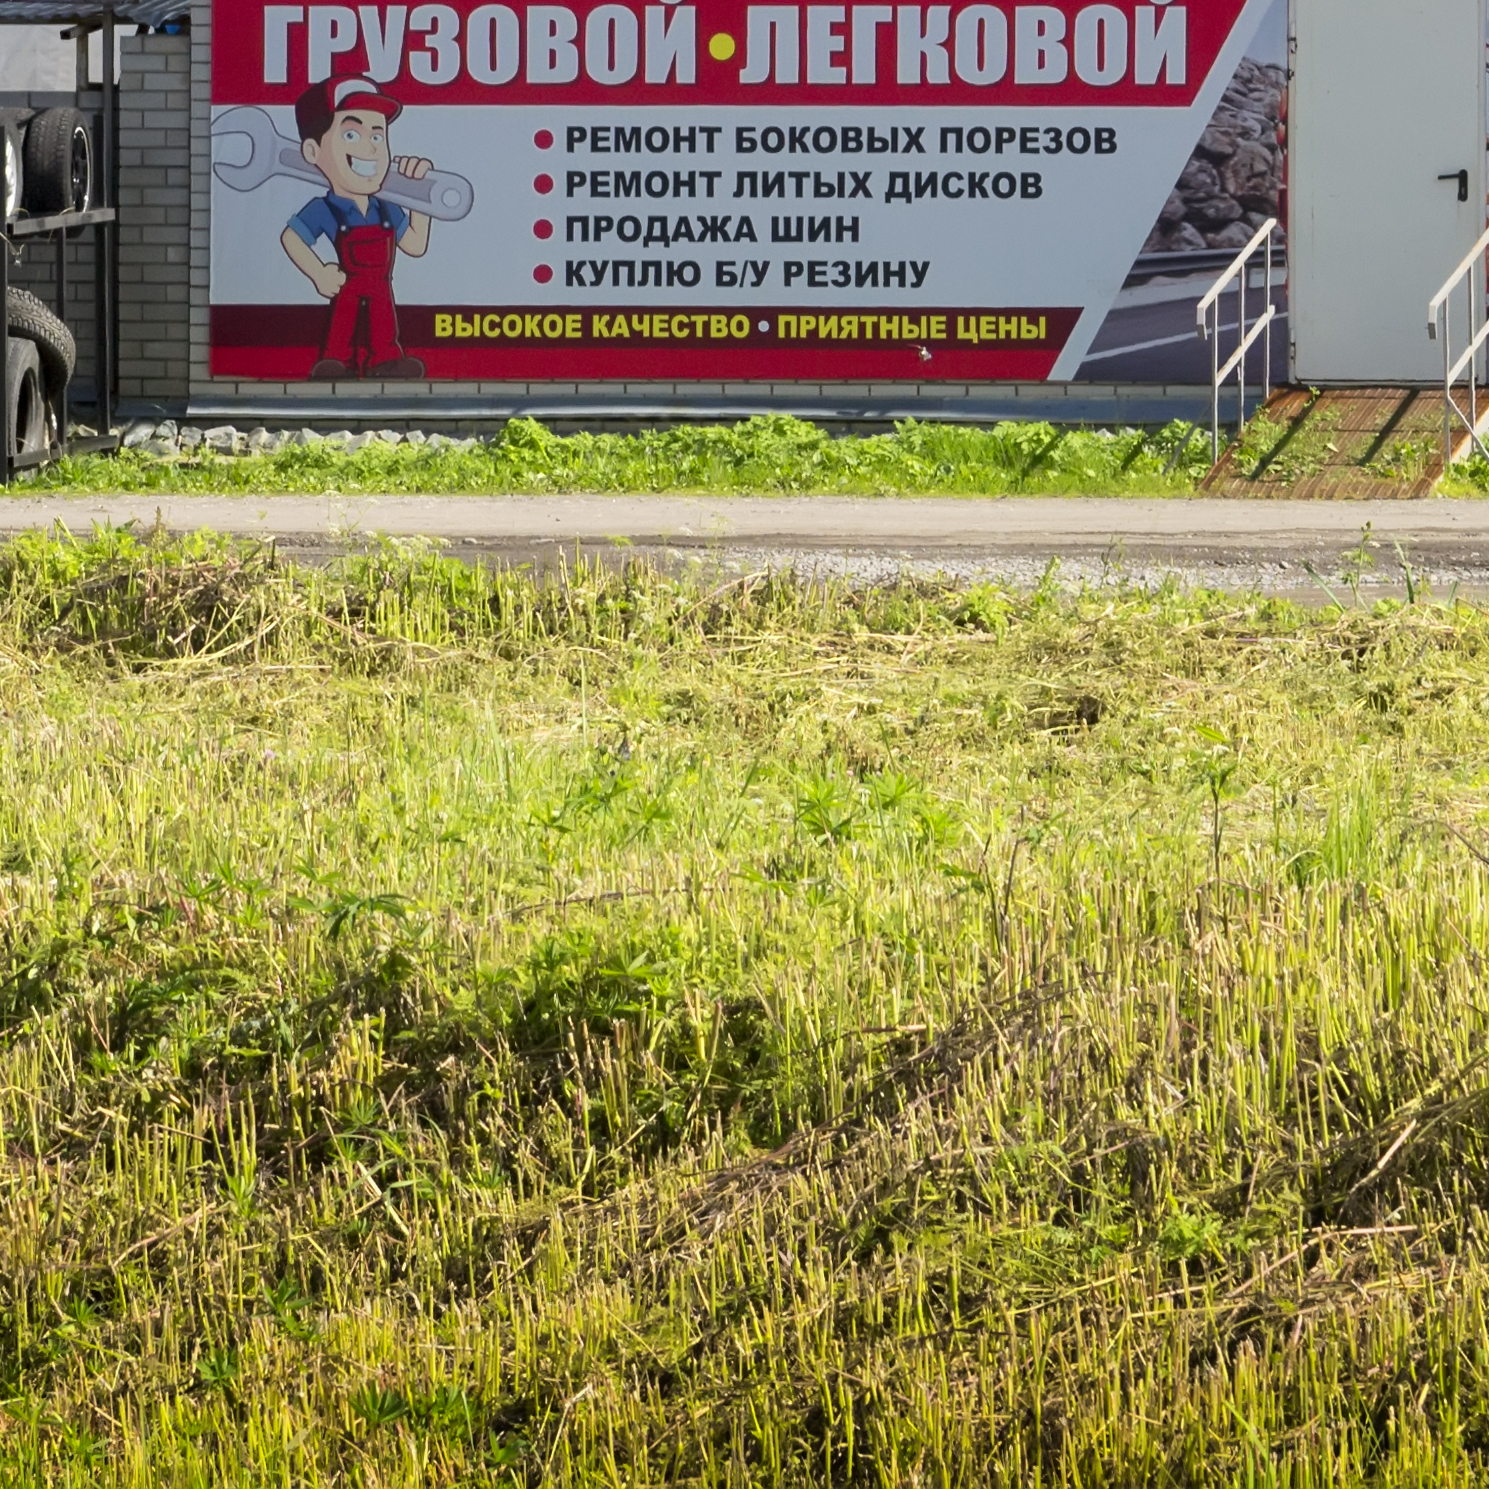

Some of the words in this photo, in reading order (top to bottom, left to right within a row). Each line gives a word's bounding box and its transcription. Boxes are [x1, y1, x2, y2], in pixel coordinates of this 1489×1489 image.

[565, 125, 722, 154] РЕМОНТ
[734, 125, 926, 154] БОКОВЫХ
[939, 125, 1118, 155] ПОРЕЗОВ
[565, 171, 722, 199] РЕМОНТ
[732, 171, 873, 200] ЛИТЫХ
[885, 171, 1044, 203] ДИСКОВ
[565, 215, 757, 248] ПРОДАЖА
[770, 216, 860, 244] ШИН
[564, 260, 701, 288] КУПЛЮ
[714, 260, 771, 289] Б/У
[783, 260, 930, 289] РЕЗИНУ
[434, 314, 582, 339] ВЫСОКОЕ
[592, 314, 751, 340] КАЧЕСТВО
[777, 314, 947, 340] ПРИЯТНЫЕ
[957, 315, 1047, 344] ЦЕНЫ
